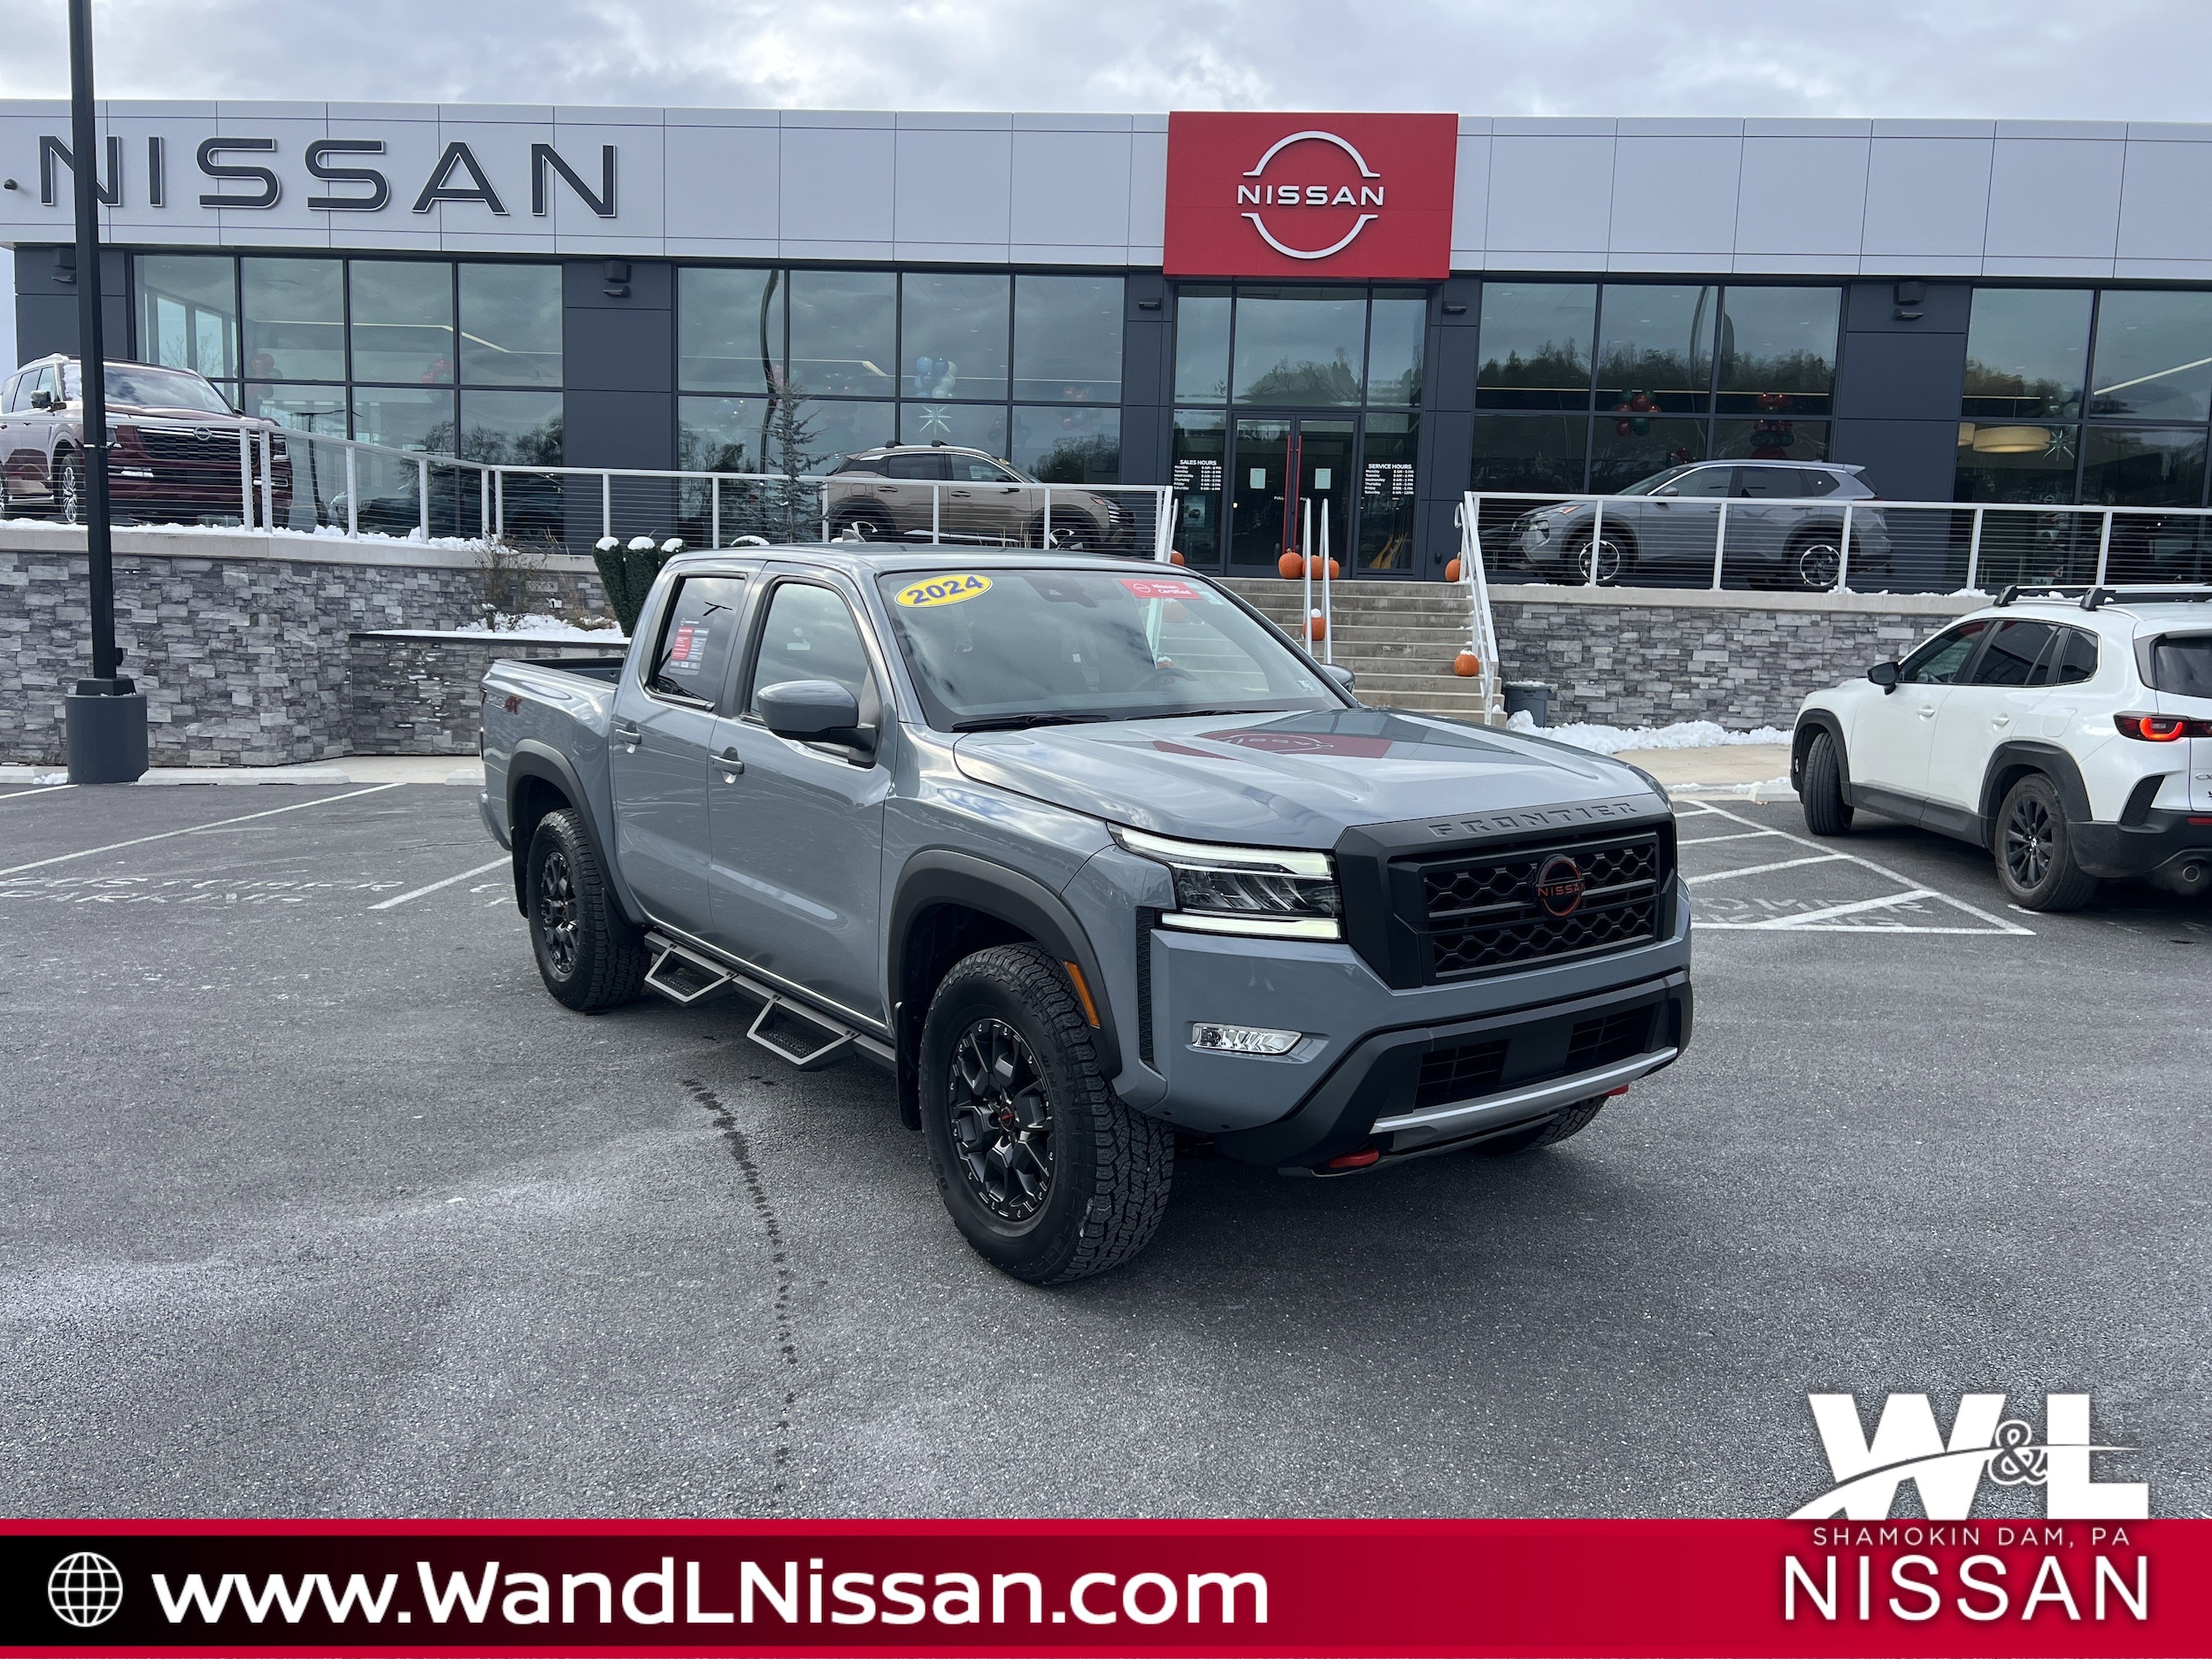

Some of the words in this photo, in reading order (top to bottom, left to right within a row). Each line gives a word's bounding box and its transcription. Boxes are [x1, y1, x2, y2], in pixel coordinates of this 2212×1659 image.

[39, 135, 618, 219] NISSAN
[1237, 185, 1385, 206] NISSAN
[907, 576, 983, 604] 2024
[1427, 803, 1638, 837] FRONTIER
[1538, 881, 1586, 897] NISSAN
